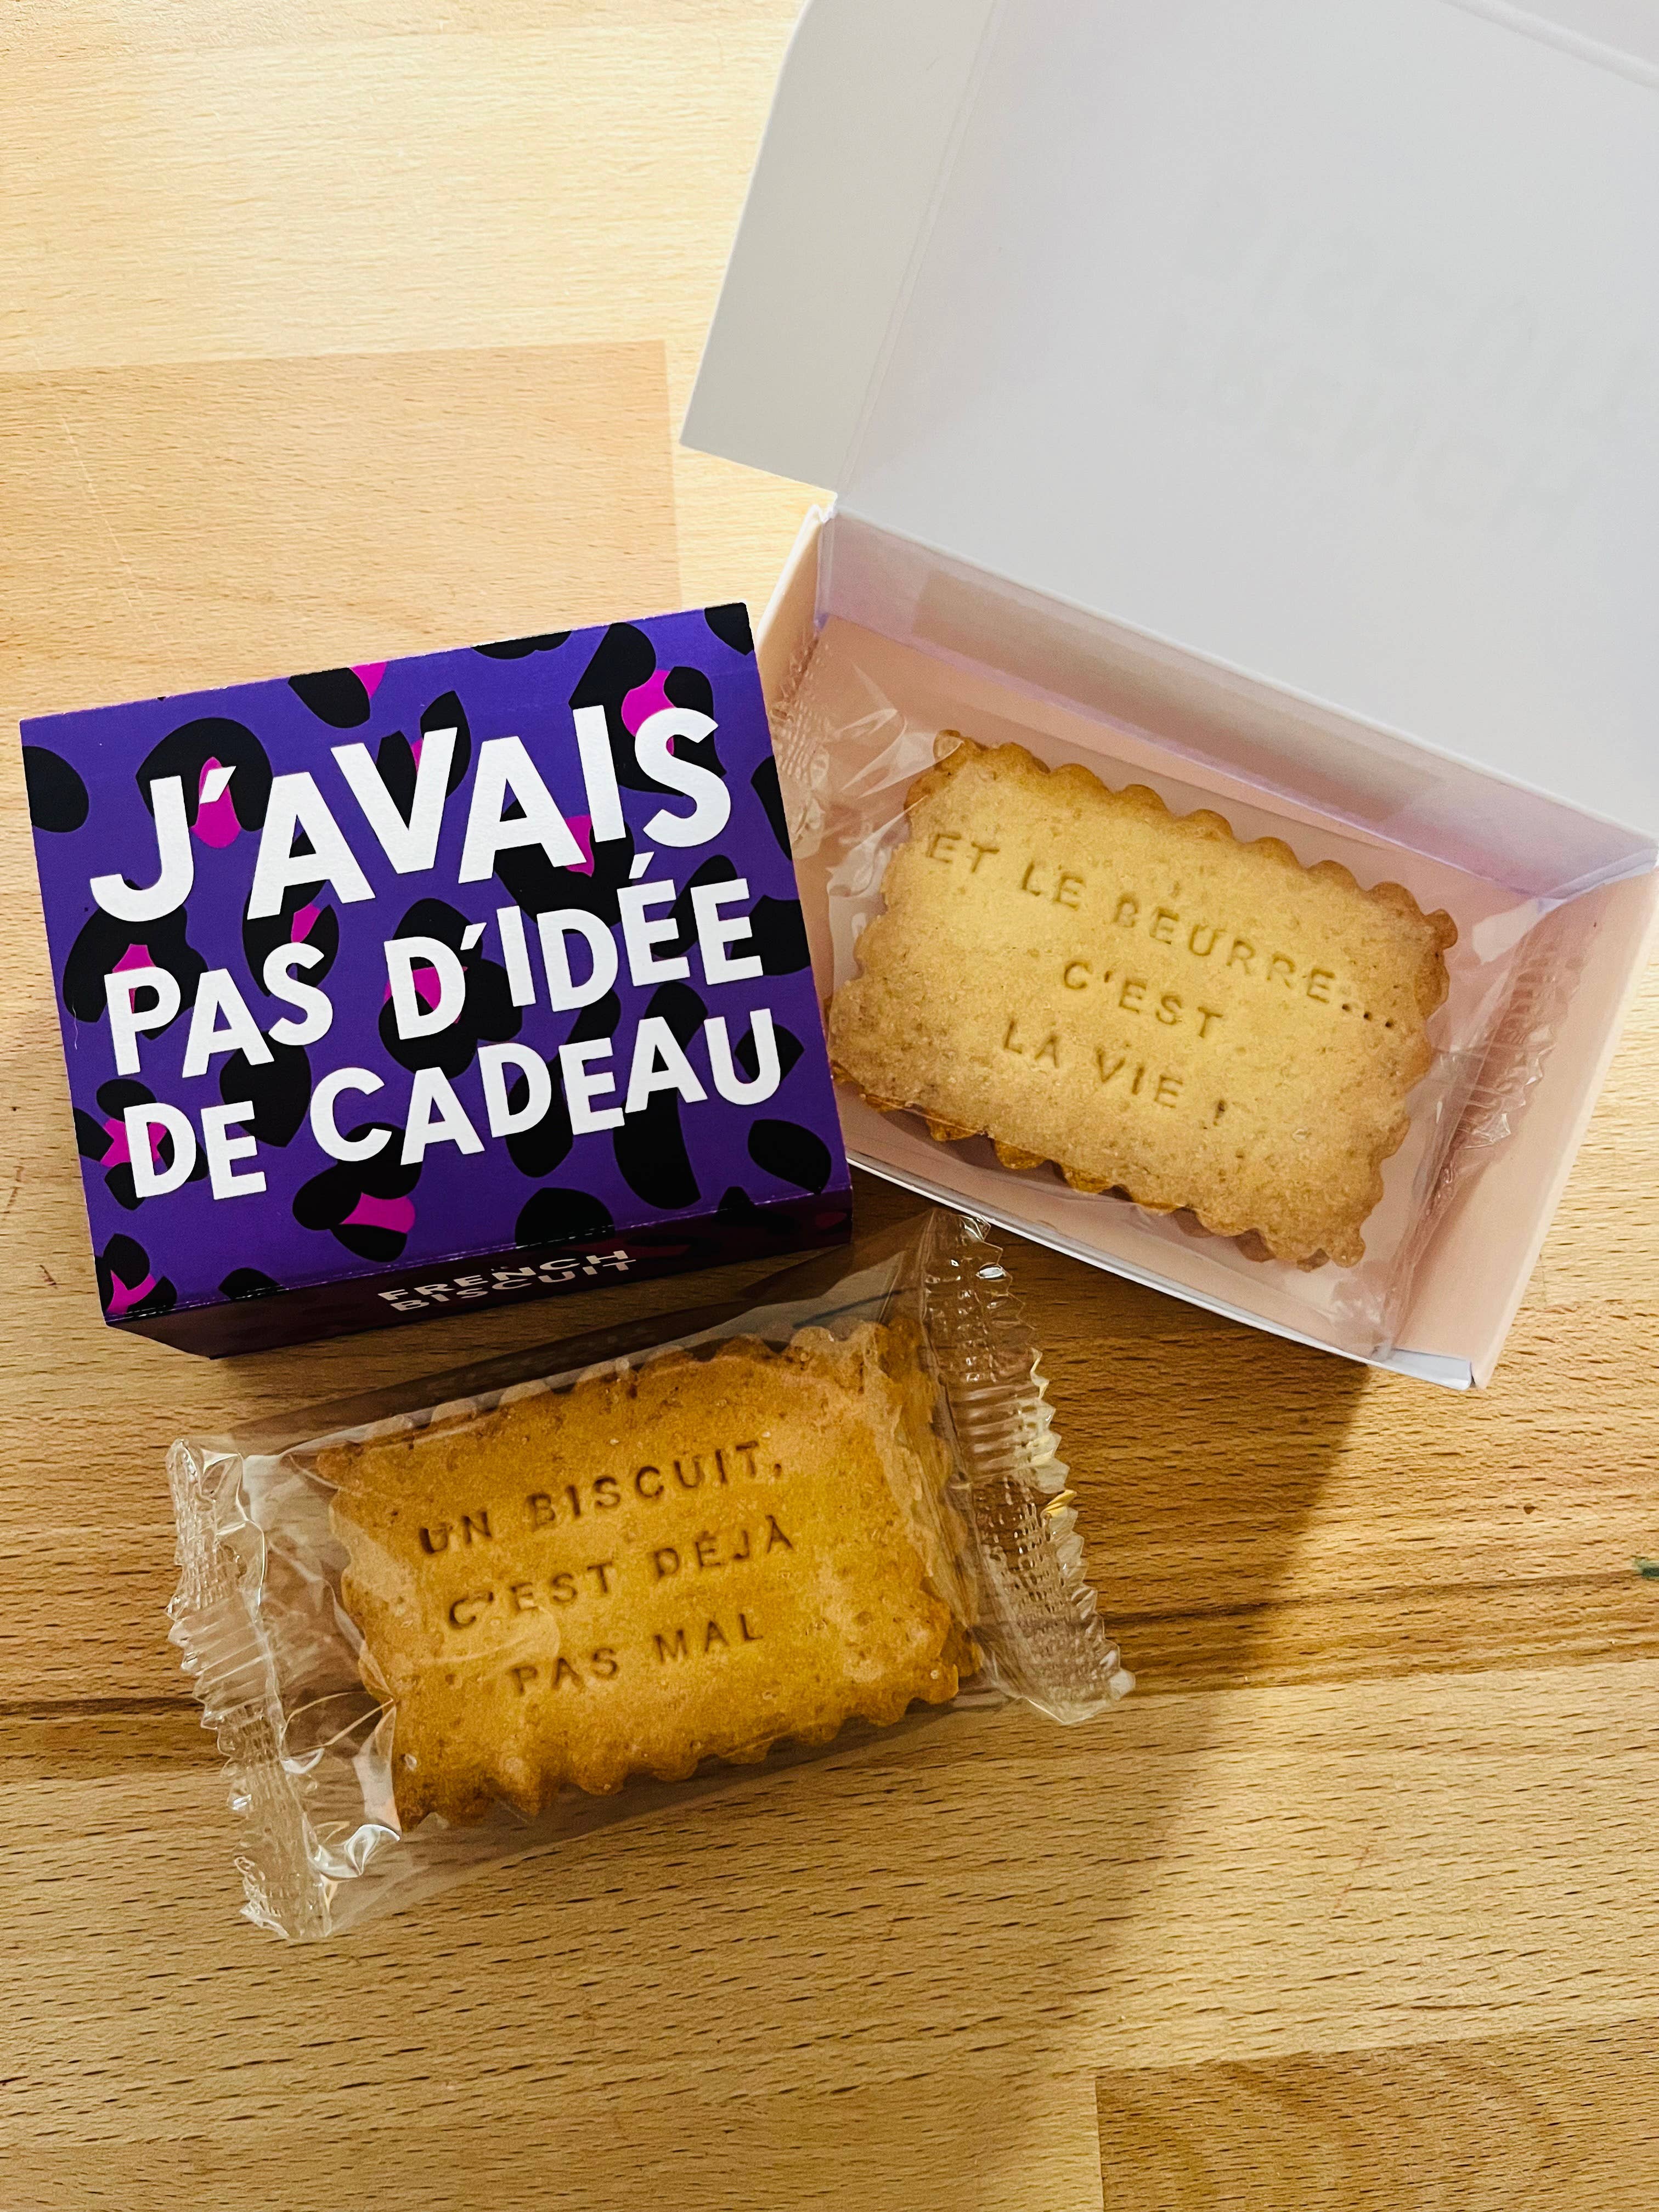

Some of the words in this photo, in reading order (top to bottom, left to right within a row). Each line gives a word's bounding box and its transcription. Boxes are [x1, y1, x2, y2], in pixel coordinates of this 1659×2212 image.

[89, 704, 731, 922] J'AVAIS
[926, 833, 999, 874] ET
[1021, 862, 1085, 909] LE
[104, 941, 334, 1078] PAS
[383, 851, 765, 1040] D'IDÉE
[1063, 960, 1223, 1038] C'EST
[1003, 1019, 1061, 1068] LA
[1096, 1049, 1184, 1108] VIE
[123, 1101, 268, 1200] DE
[310, 1008, 781, 1166] CADEAU
[378, 1250, 629, 1301] FRENCH
[390, 1259, 637, 1311] BISCUIT
[419, 1511, 493, 1555] UN
[448, 1561, 614, 1629] C'EST
[509, 1647, 619, 1696] PAS
[654, 1613, 763, 1663] MAL
